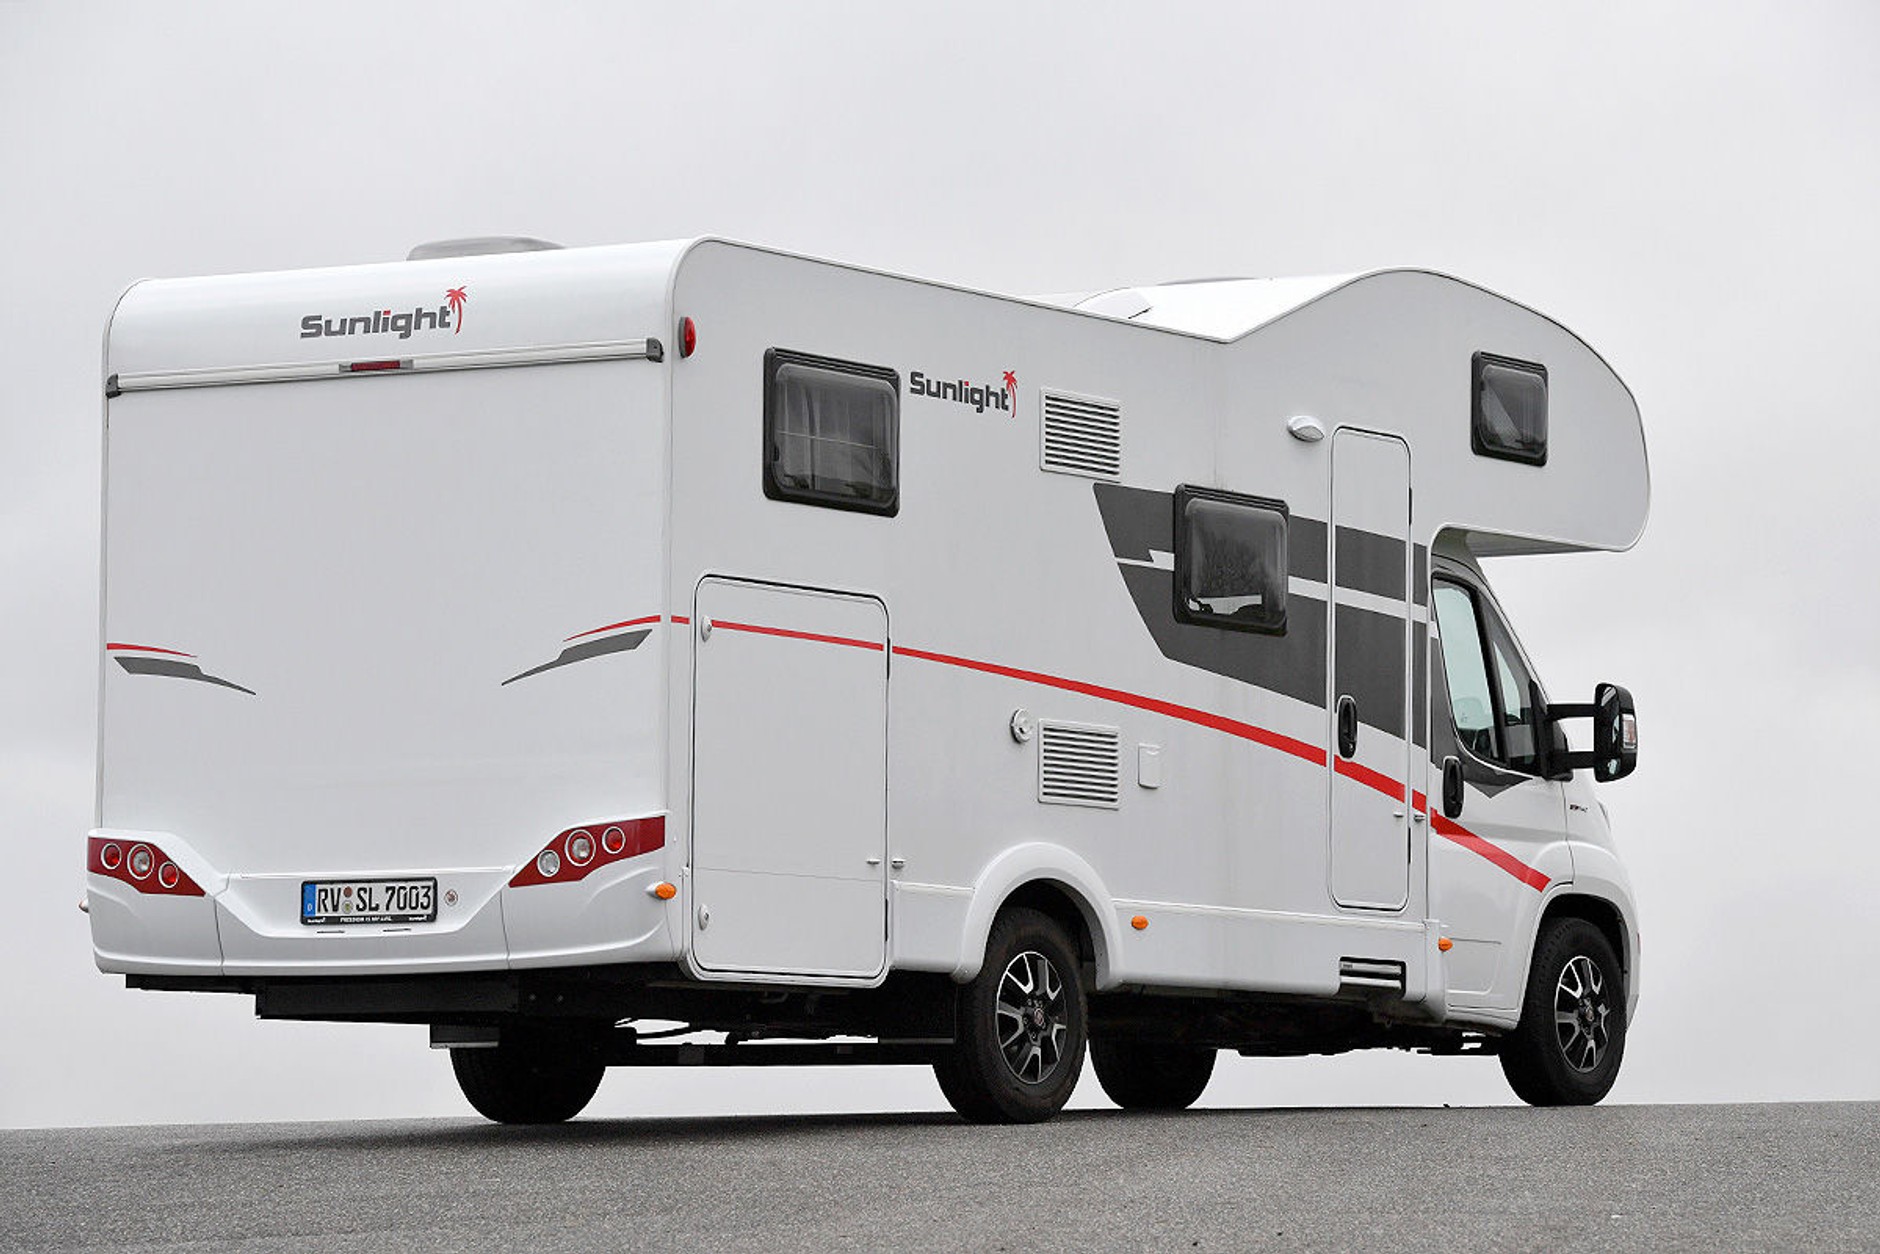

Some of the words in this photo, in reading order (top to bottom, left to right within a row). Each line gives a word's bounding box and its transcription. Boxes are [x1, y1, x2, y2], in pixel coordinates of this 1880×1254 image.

[300, 305, 451, 339] Sunlight
[910, 371, 1009, 413] Sunlight
[317, 888, 341, 913] RV
[356, 887, 380, 911] SL
[385, 886, 431, 911] 7003
